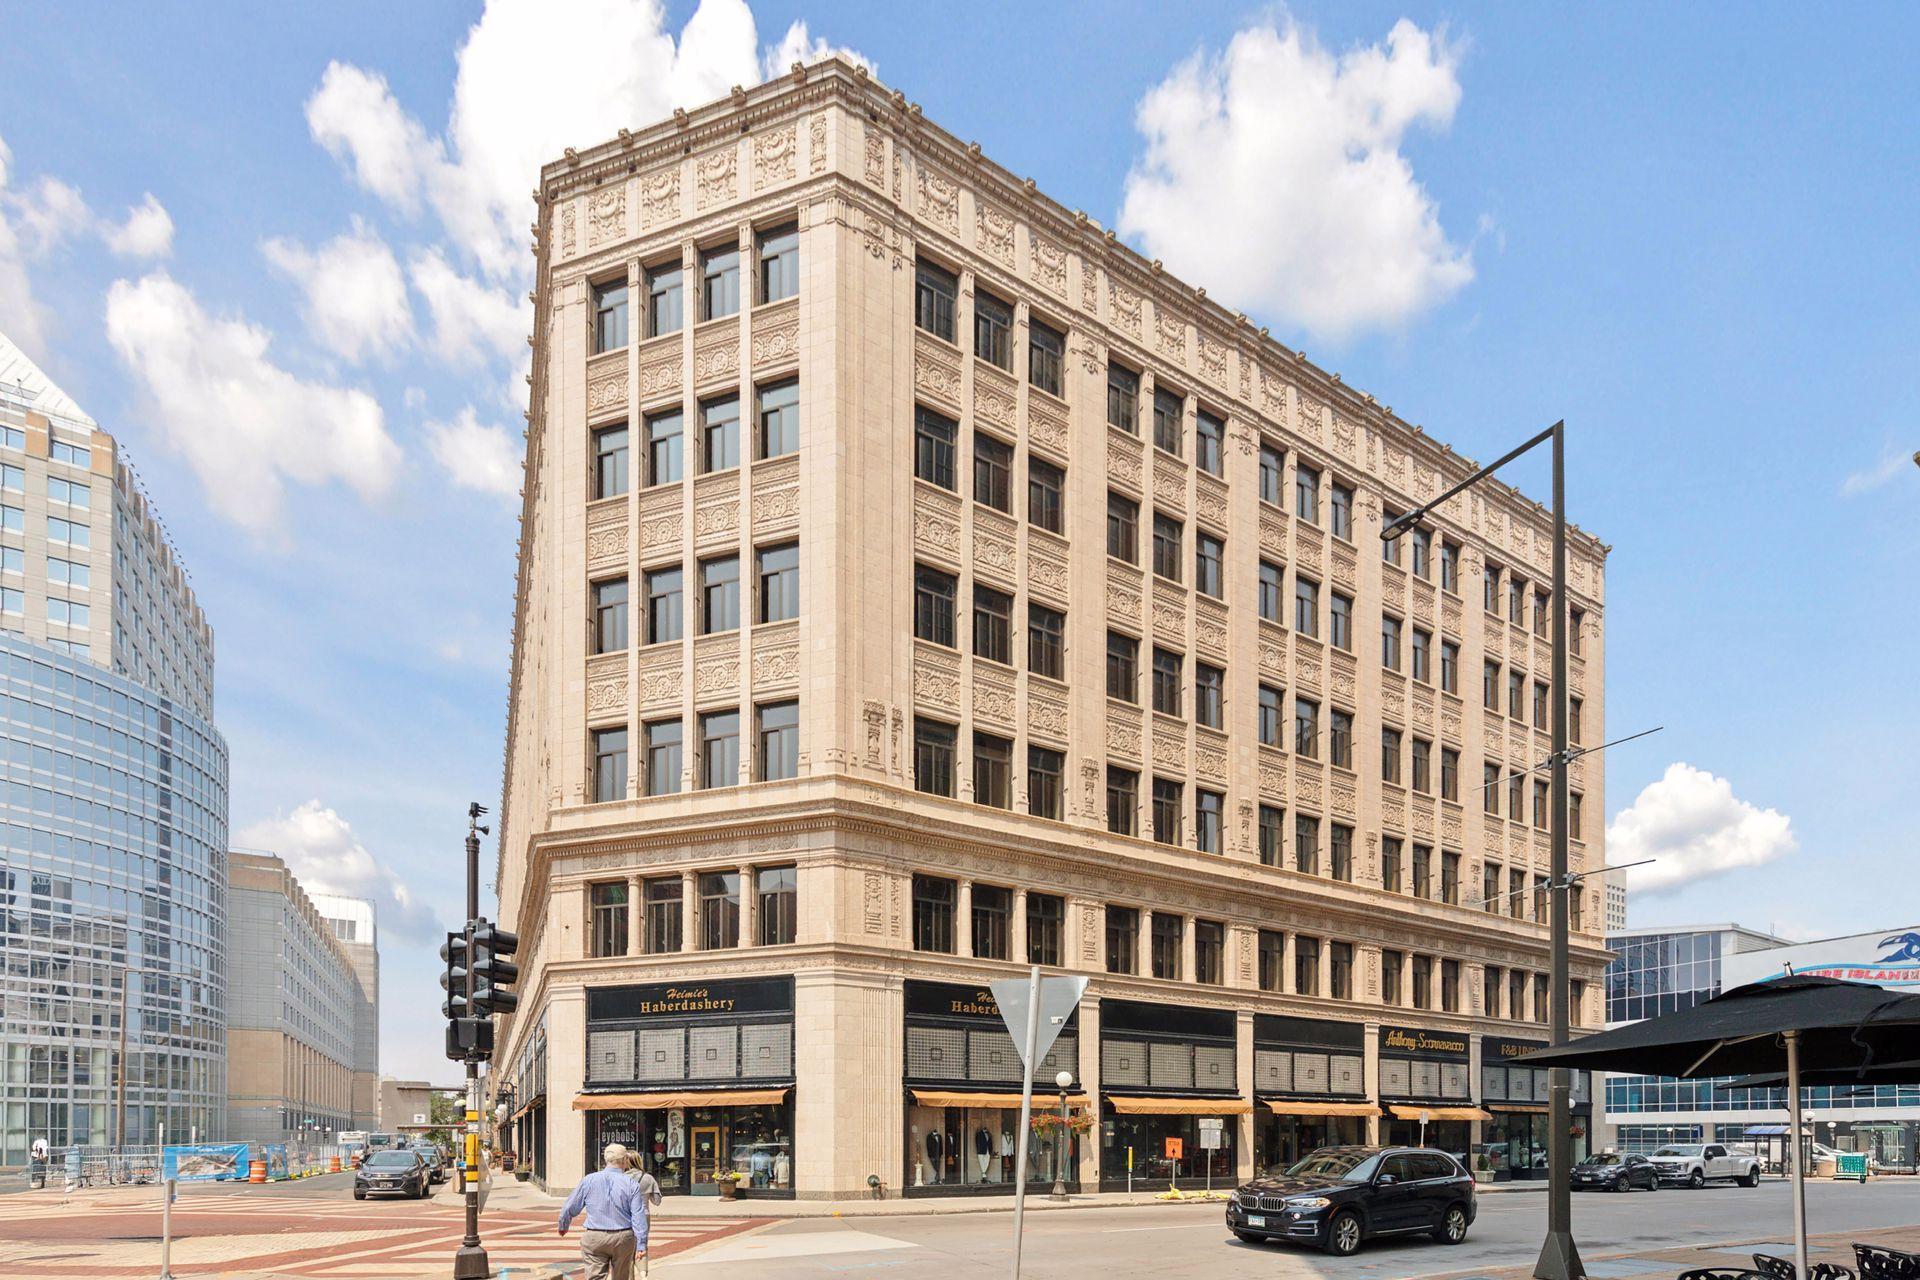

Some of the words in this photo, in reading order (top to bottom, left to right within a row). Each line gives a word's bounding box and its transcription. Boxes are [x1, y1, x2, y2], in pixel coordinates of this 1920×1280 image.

[640, 998, 735, 1014] Haberdashery
[1385, 1030, 1416, 1051] Anthony
[601, 1129, 635, 1144] eyebobs
